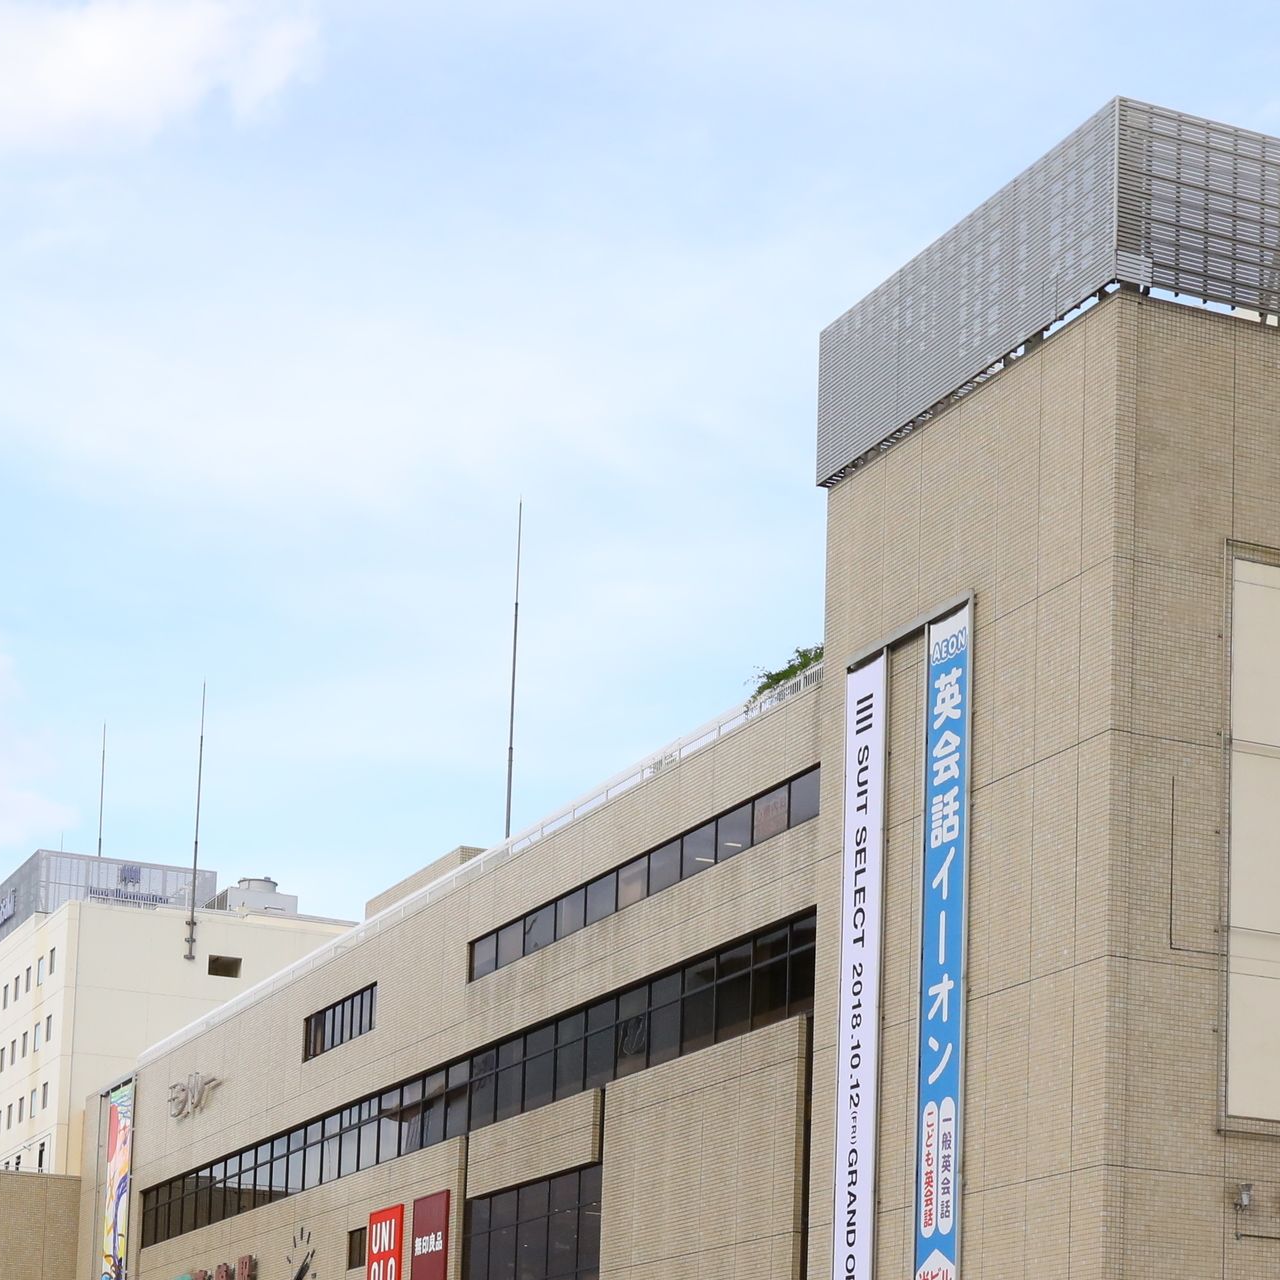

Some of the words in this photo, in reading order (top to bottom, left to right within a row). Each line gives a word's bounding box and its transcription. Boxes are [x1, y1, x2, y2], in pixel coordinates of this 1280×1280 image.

[930, 627, 968, 666] AEON
[855, 744, 871, 816] SUIT
[853, 825, 868, 949] SELECT
[928, 667, 962, 1086] 英会話イーオン
[922, 1110, 935, 1228] こども英会話
[939, 1116, 953, 1220] 一般英会話
[371, 1218, 396, 1255] UNI
[414, 1231, 443, 1256] 無印良品
